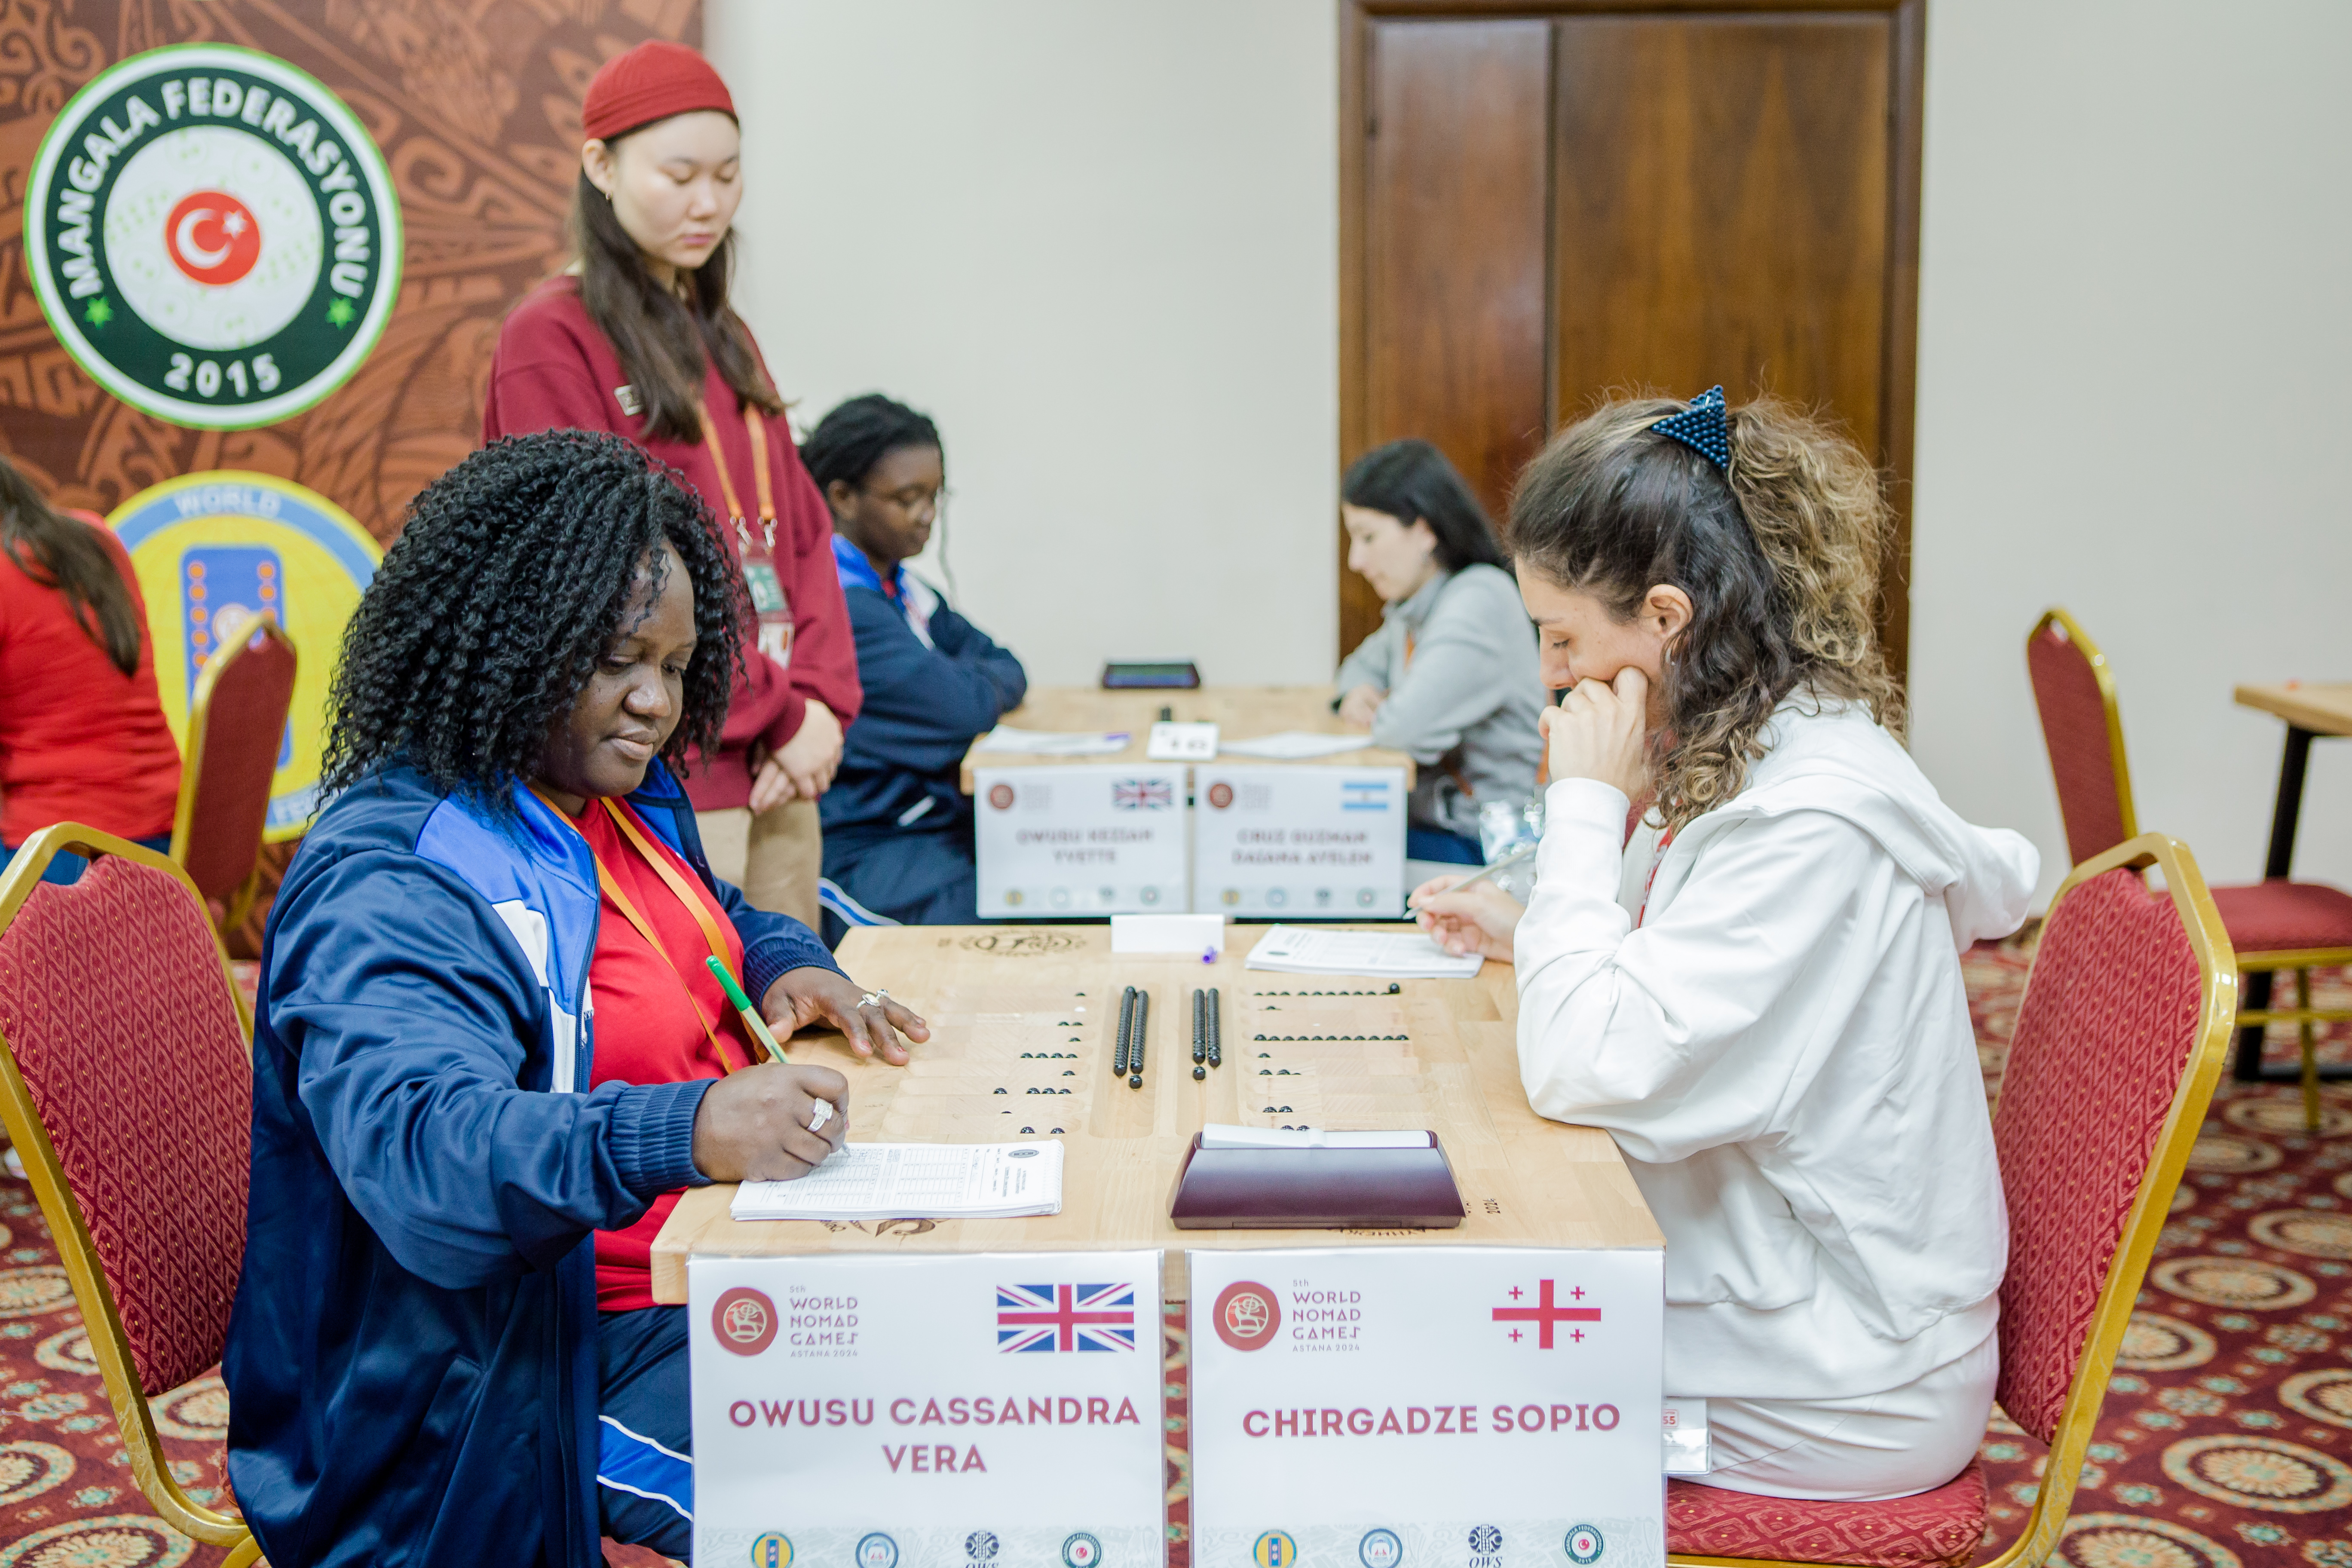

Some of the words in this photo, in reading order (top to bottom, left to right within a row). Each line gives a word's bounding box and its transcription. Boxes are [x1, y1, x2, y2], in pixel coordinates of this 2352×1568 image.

[57, 95, 162, 299] MANGALA
[161, 77, 371, 298] FEDERASYONU
[163, 352, 281, 398] 2015
[173, 485, 281, 518] WORLD
[790, 1285, 806, 1293] 5th
[1293, 1279, 1309, 1287] 5th
[790, 1297, 858, 1311] WORLD
[1292, 1291, 1361, 1304] WORLD
[790, 1315, 858, 1328] NOMAD
[1293, 1309, 1361, 1322] NOMAD
[790, 1332, 858, 1346] GAMES
[1292, 1326, 1361, 1340] GAMES
[729, 1399, 875, 1428] OWUSU
[890, 1396, 1141, 1426] CASSANDRA
[1243, 1406, 1479, 1438] CHIRGADZE
[1492, 1403, 1620, 1433] SOPIO
[882, 1444, 988, 1474] VERA
[1469, 1556, 1503, 1568] OWS
